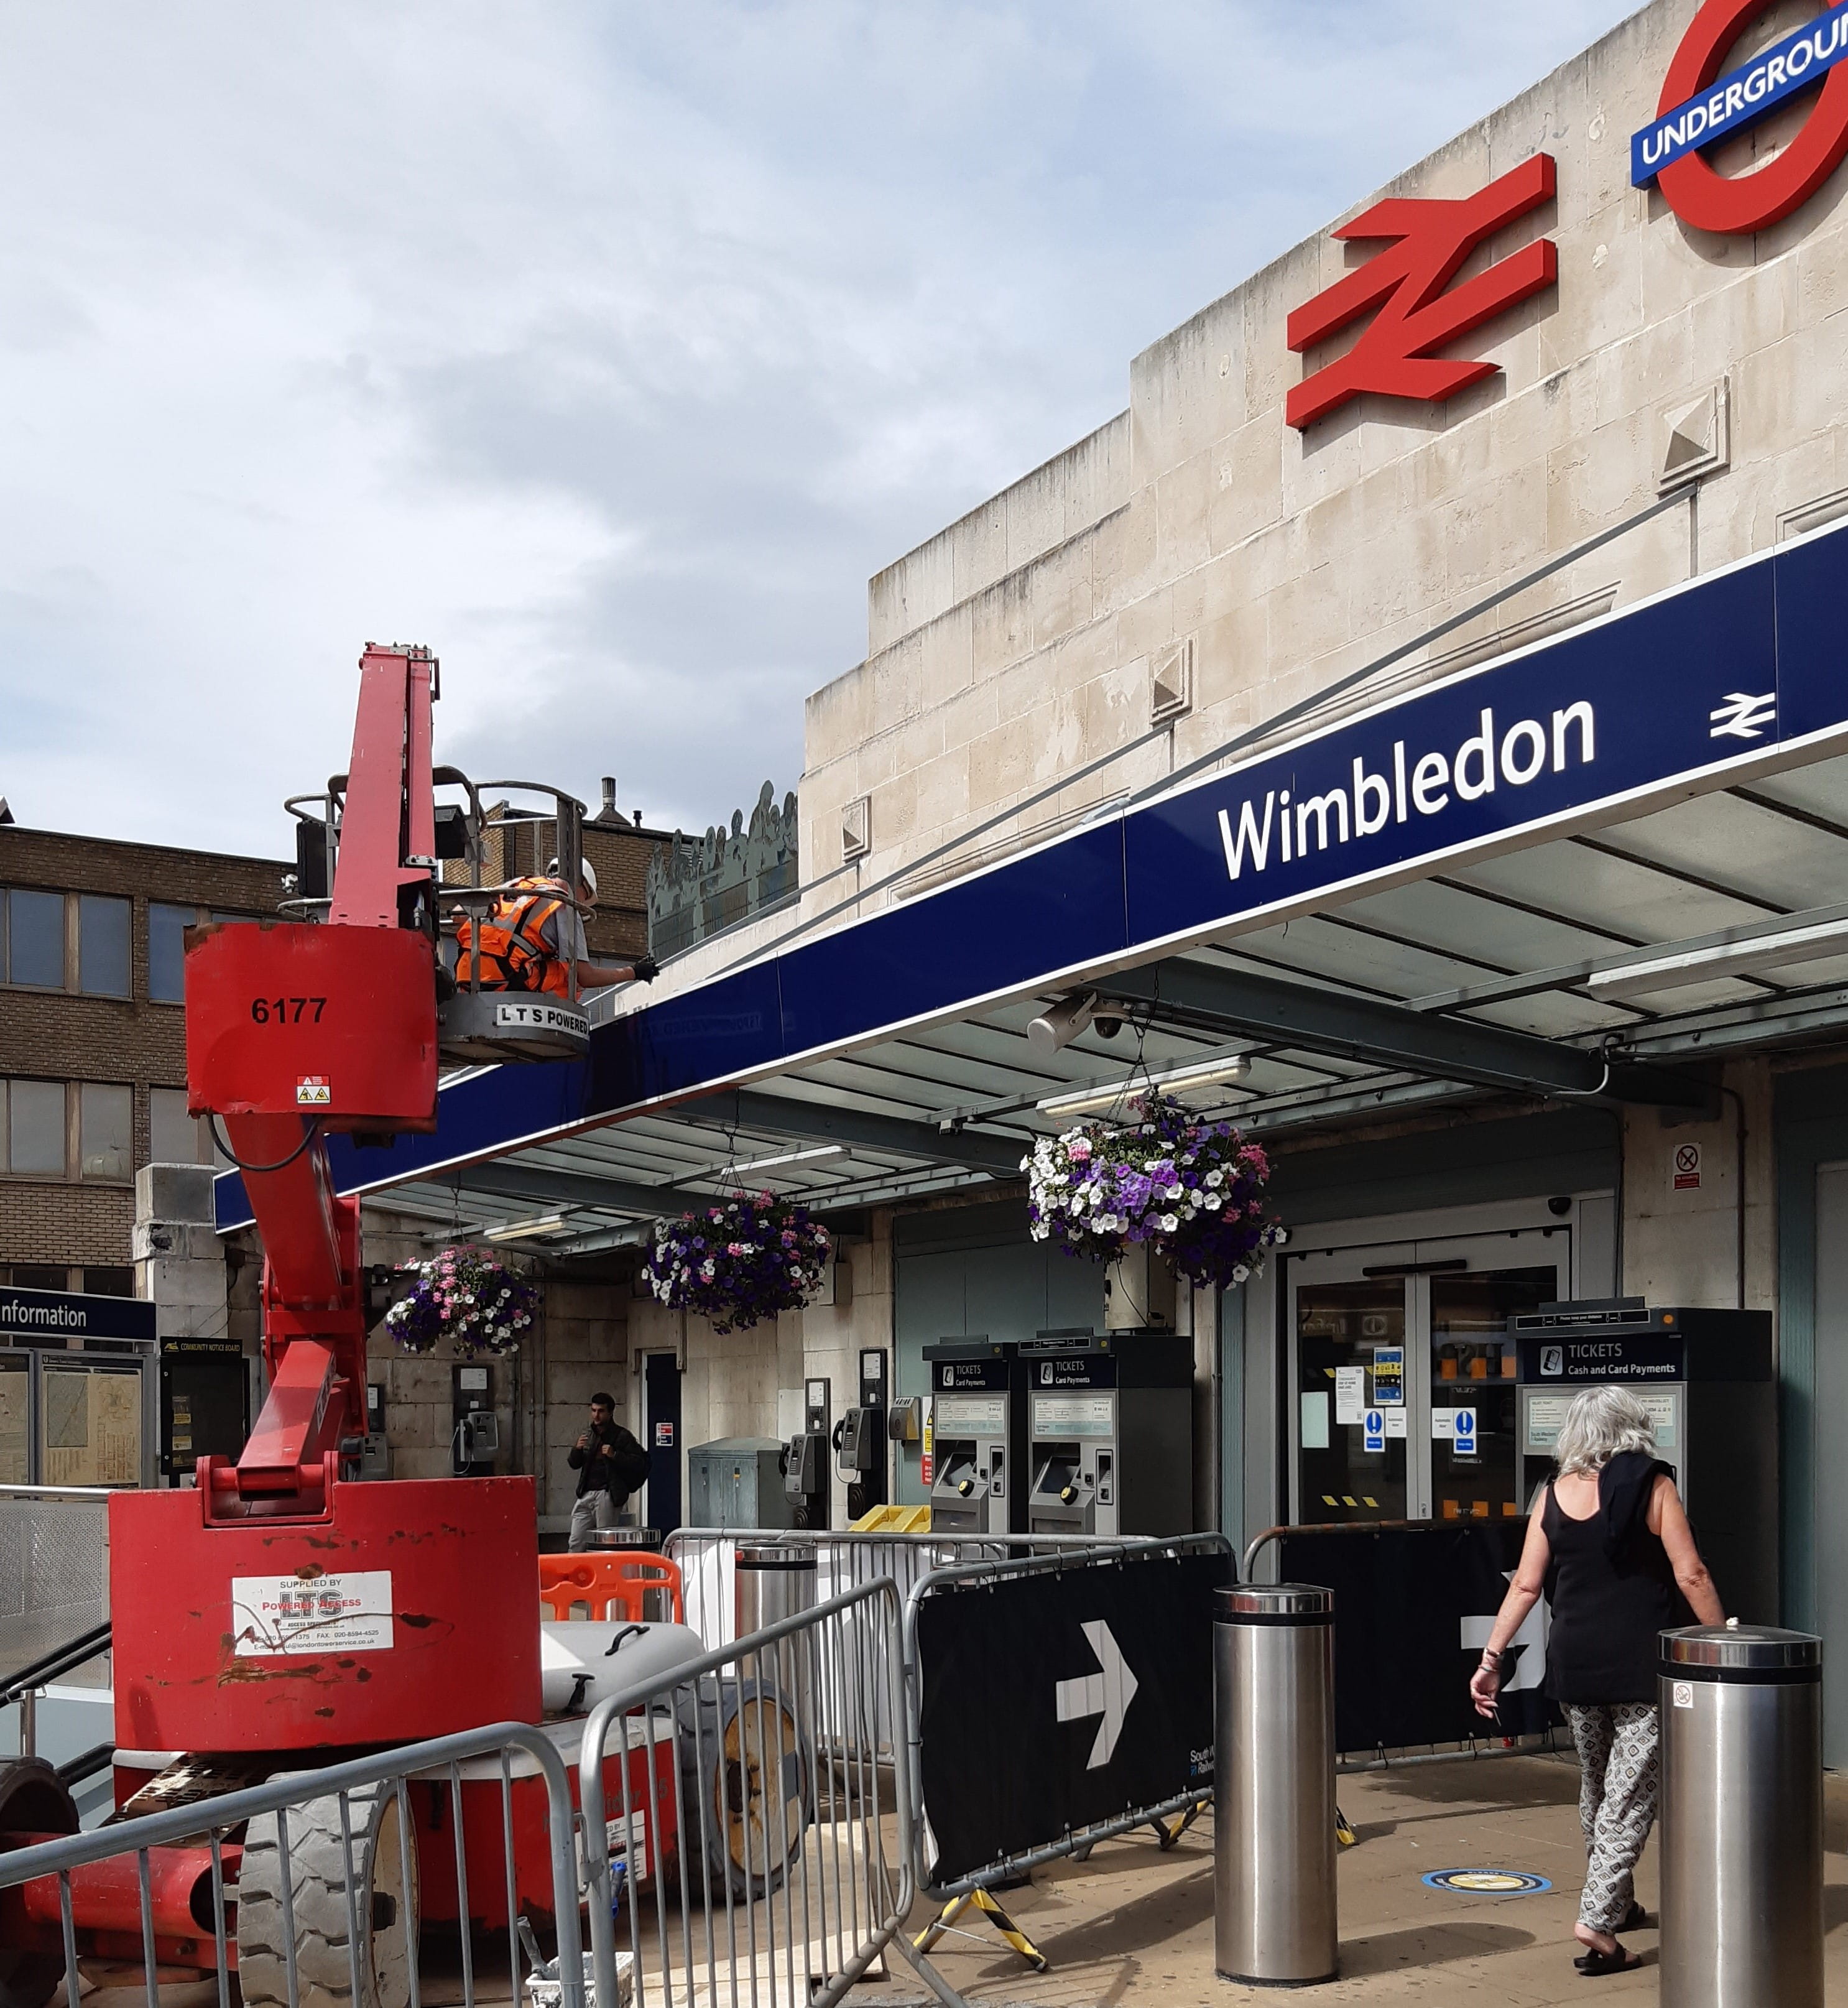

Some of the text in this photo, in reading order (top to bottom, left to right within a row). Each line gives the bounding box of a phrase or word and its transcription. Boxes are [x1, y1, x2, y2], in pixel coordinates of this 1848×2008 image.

[1217, 701, 1594, 881] Wimbledon
[251, 997, 327, 1024] 6177
[548, 1011, 588, 1035] POWERED
[1, 1299, 86, 1327] nformation
[180, 1343, 208, 1351] COMMUNITY
[209, 1343, 224, 1352] NOTICE
[225, 1344, 240, 1352] BOARD
[1568, 1343, 1622, 1358] TICKETS
[956, 1364, 981, 1375] TICKETS
[1056, 1361, 1085, 1371] TICKETS
[1568, 1363, 1676, 1376] Cash and Card Payments
[966, 1379, 986, 1387] Payments
[1067, 1376, 1090, 1385] Payments
[280, 1579, 326, 1588] SUPPLIED
[262, 1599, 361, 1611] POWERED ACCESS
[280, 1589, 344, 1619] LTS
[334, 1629, 379, 1638] 020-8594-4525
[1190, 1747, 1209, 1762] South
